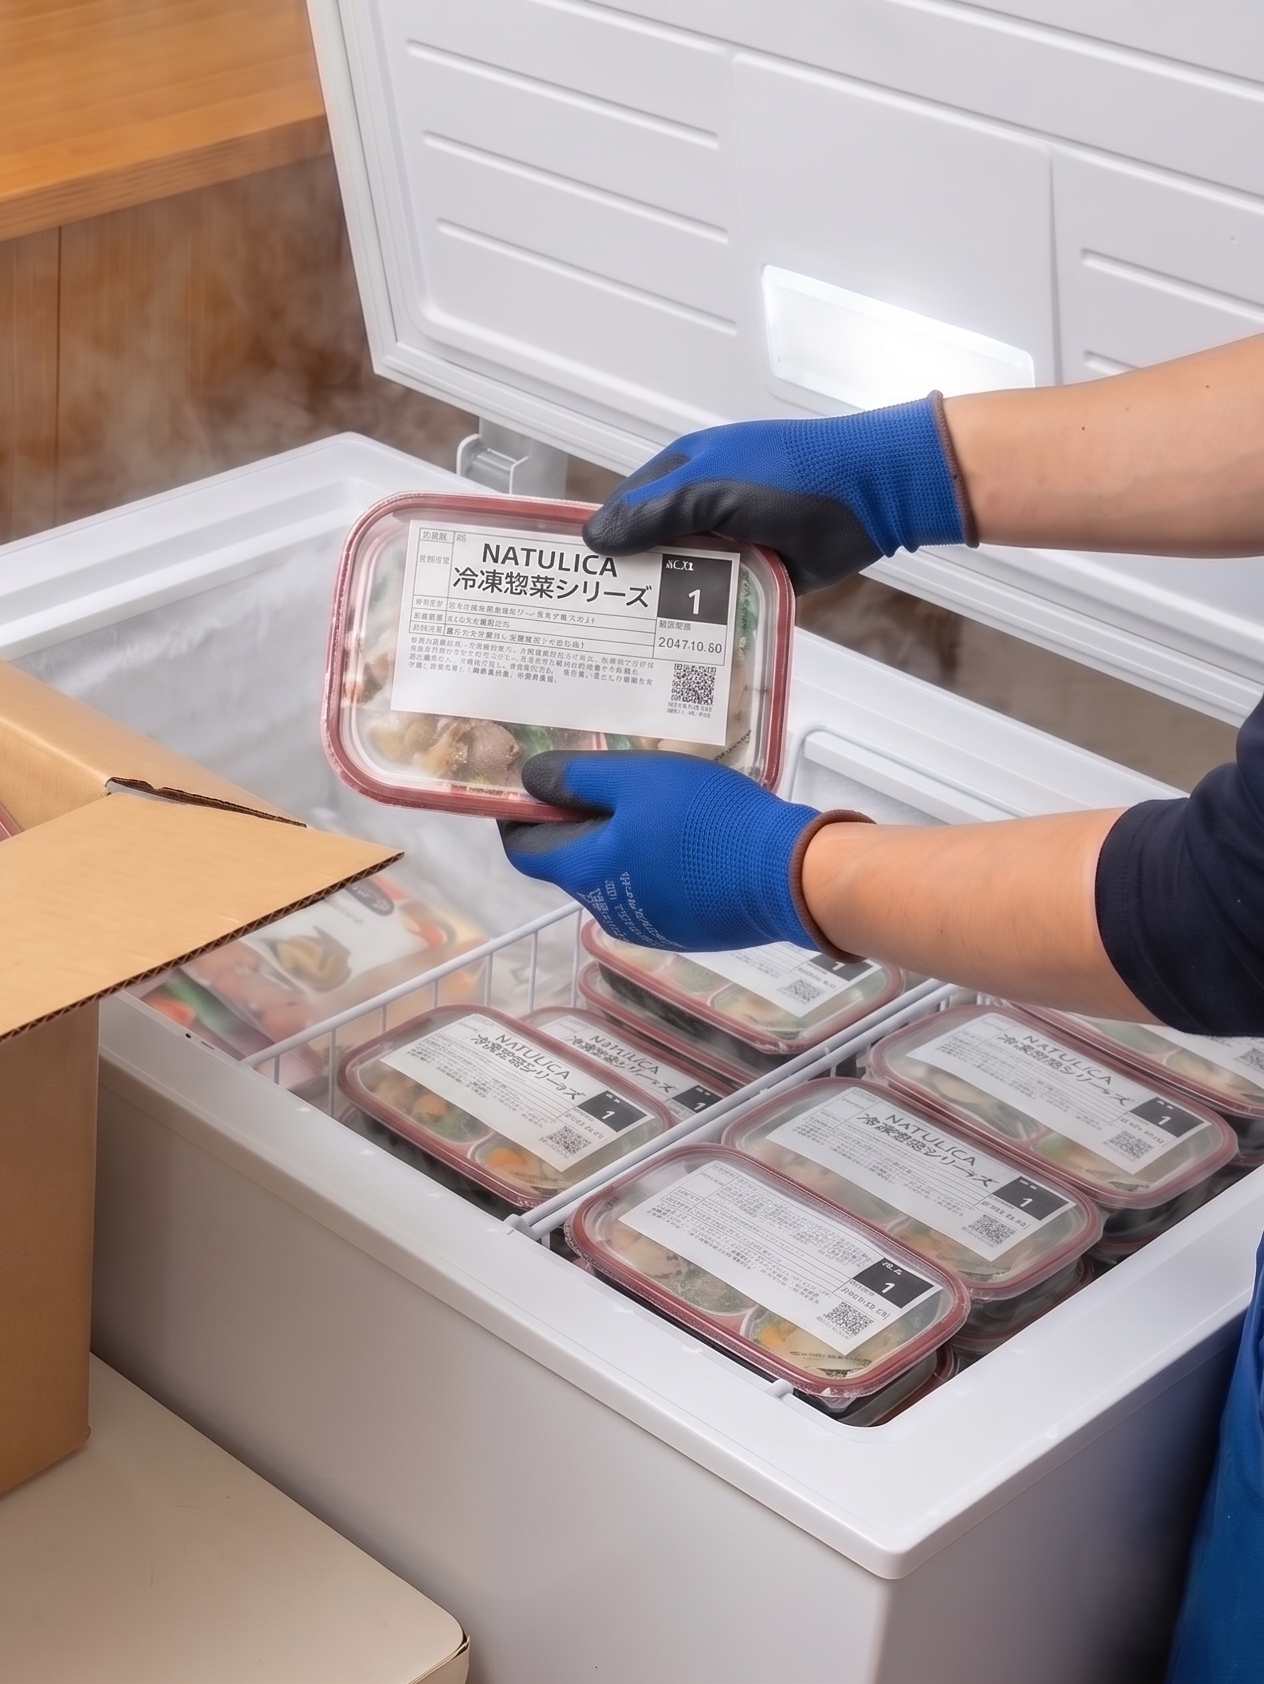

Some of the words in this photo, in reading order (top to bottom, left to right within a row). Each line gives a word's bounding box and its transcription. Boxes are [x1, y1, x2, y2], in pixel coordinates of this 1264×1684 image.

[482, 543, 618, 578] NATULICA
[453, 566, 652, 608] 冷凍惣菜シリーズ
[688, 589, 701, 615] 1
[602, 1110, 616, 1120] 1
[881, 1282, 896, 1294] 1
